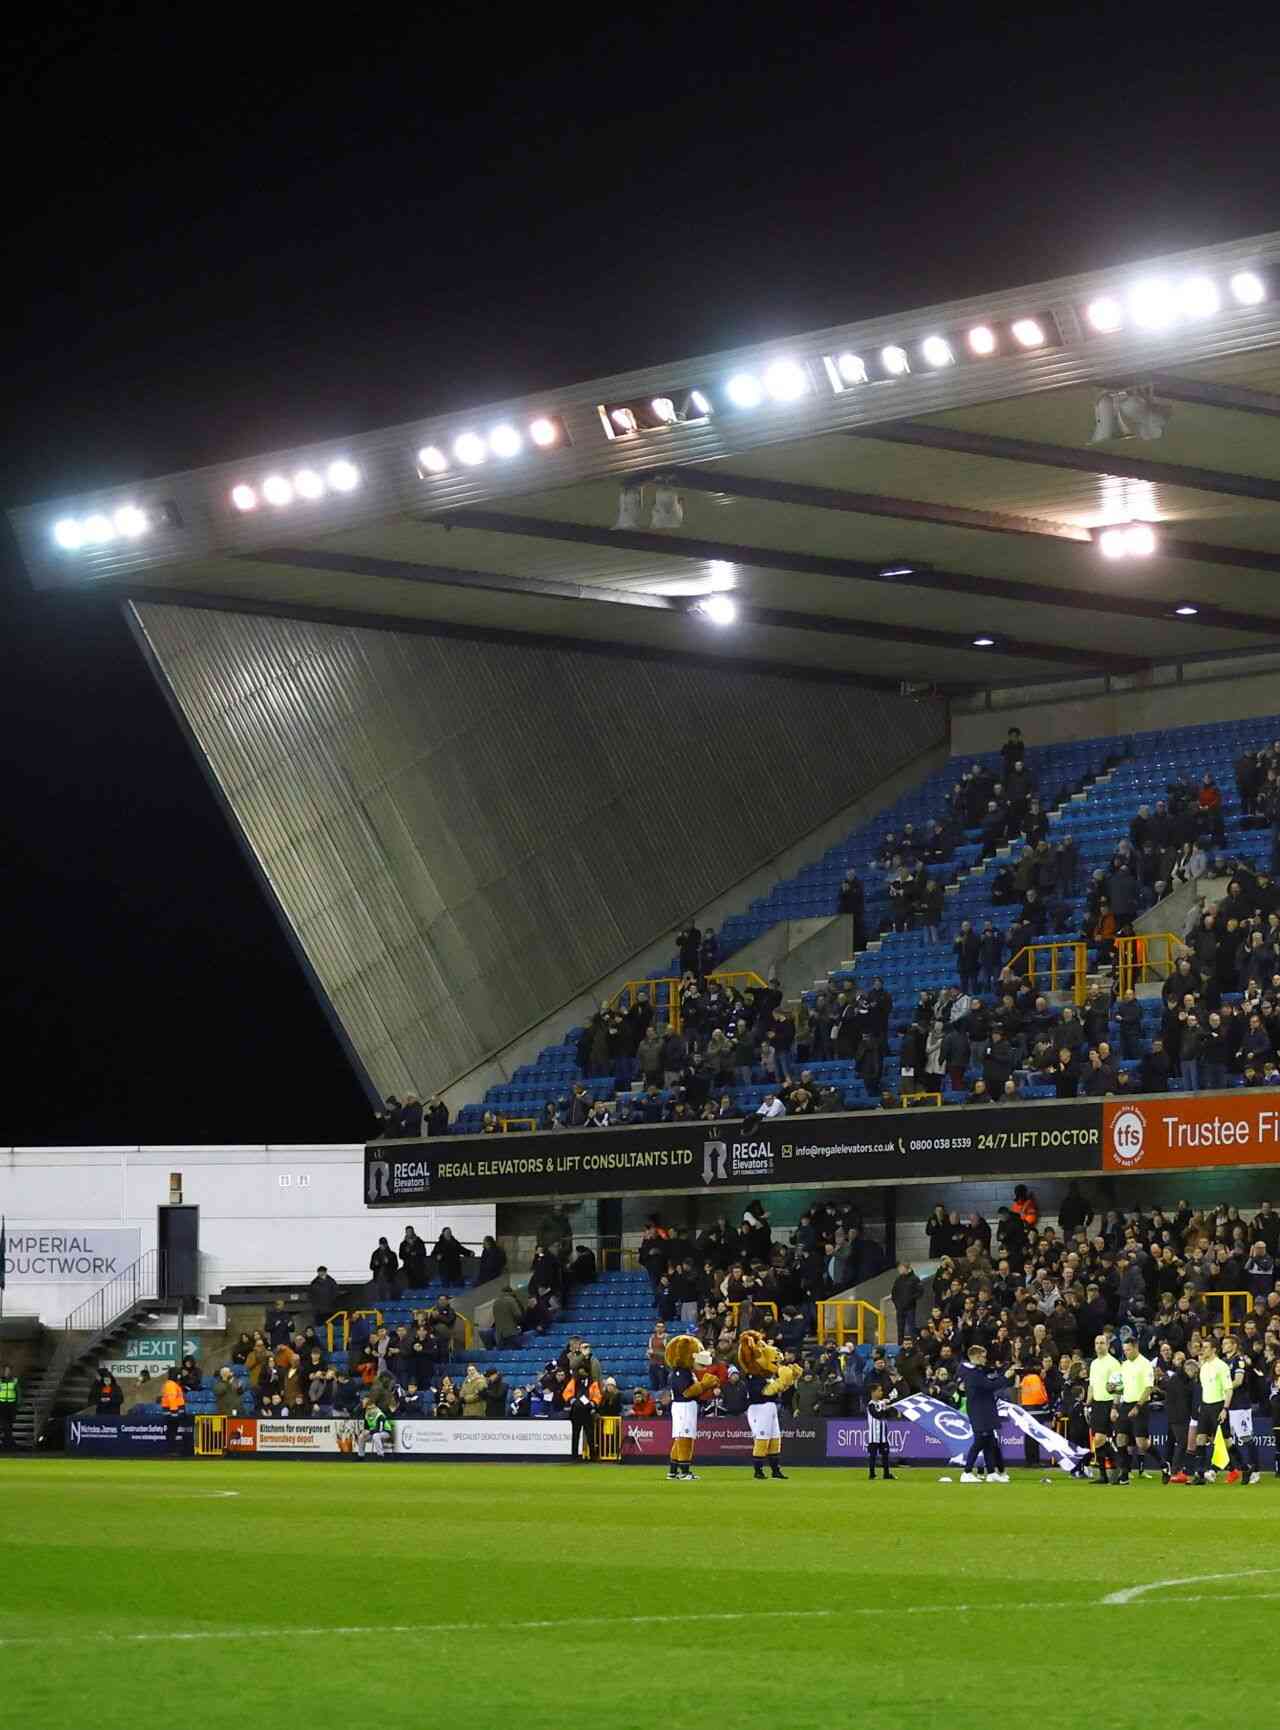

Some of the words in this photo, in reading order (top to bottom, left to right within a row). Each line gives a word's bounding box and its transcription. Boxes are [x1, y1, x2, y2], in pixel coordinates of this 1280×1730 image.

[977, 1134, 1007, 1149] 24/7
[1010, 1132, 1038, 1147] LIFT
[1041, 1129, 1098, 1146] DOCTOR
[1117, 1124, 1140, 1147] tfs
[1162, 1116, 1248, 1148] Trustee
[732, 1142, 774, 1159] REGAL
[796, 1142, 895, 1158] info@regalelevators.co.uk
[910, 1140, 932, 1150] 0800
[934, 1139, 950, 1149] 038
[952, 1137, 971, 1148] 5339
[394, 1161, 430, 1178] REGAL
[438, 1162, 475, 1177] REGAL
[478, 1156, 543, 1175] ELEVATORS
[546, 1158, 554, 1172] &
[557, 1155, 580, 1172] LIFT
[583, 1150, 668, 1169] CONSULTANTS
[671, 1149, 693, 1165] LTD
[732, 1159, 768, 1169] Elevators
[394, 1178, 424, 1187] Elevators
[3, 1257, 116, 1274] DUCTWORK
[139, 1341, 176, 1356] EXIT
[111, 1364, 138, 1374] FIRST
[144, 1363, 159, 1373] AID
[260, 1424, 285, 1432] Kitchens
[286, 1424, 294, 1432] for
[295, 1426, 322, 1434] everyone
[712, 1430, 726, 1439] your
[797, 1430, 815, 1438] future
